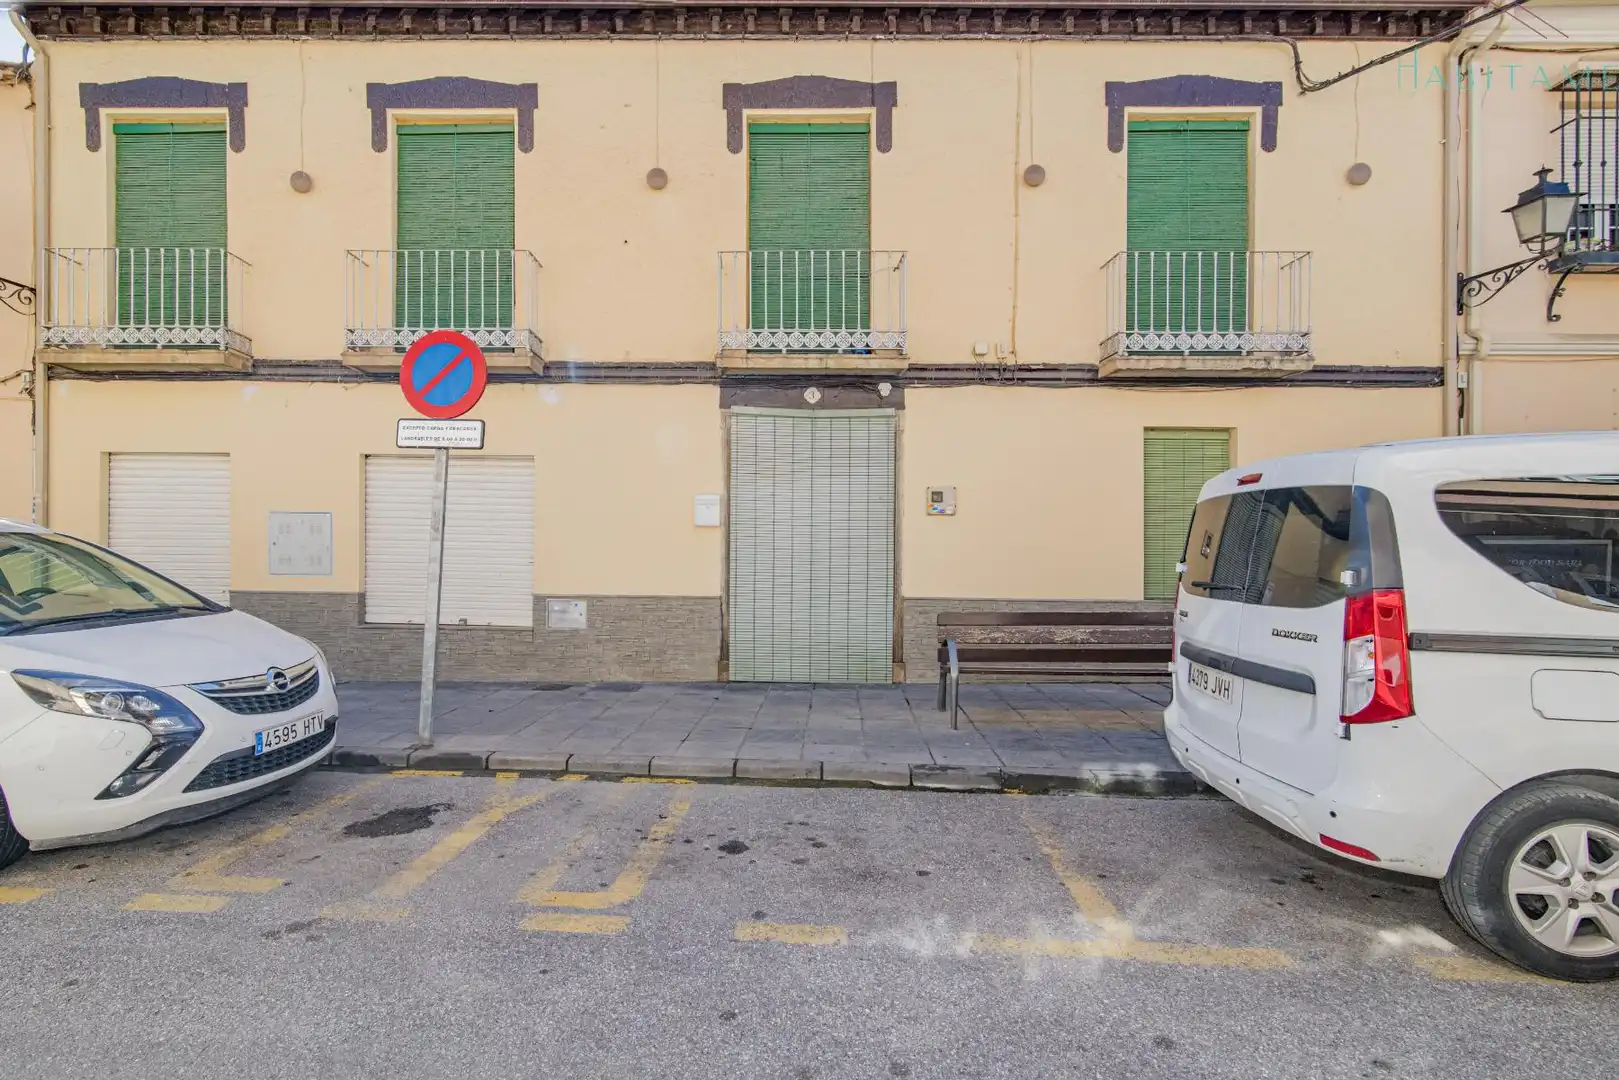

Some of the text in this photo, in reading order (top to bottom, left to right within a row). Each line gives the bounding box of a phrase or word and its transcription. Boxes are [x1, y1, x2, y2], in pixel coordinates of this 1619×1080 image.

[1271, 628, 1318, 643] DOKKER
[1211, 676, 1231, 700] JVH
[265, 714, 323, 747] 4595 HTV
